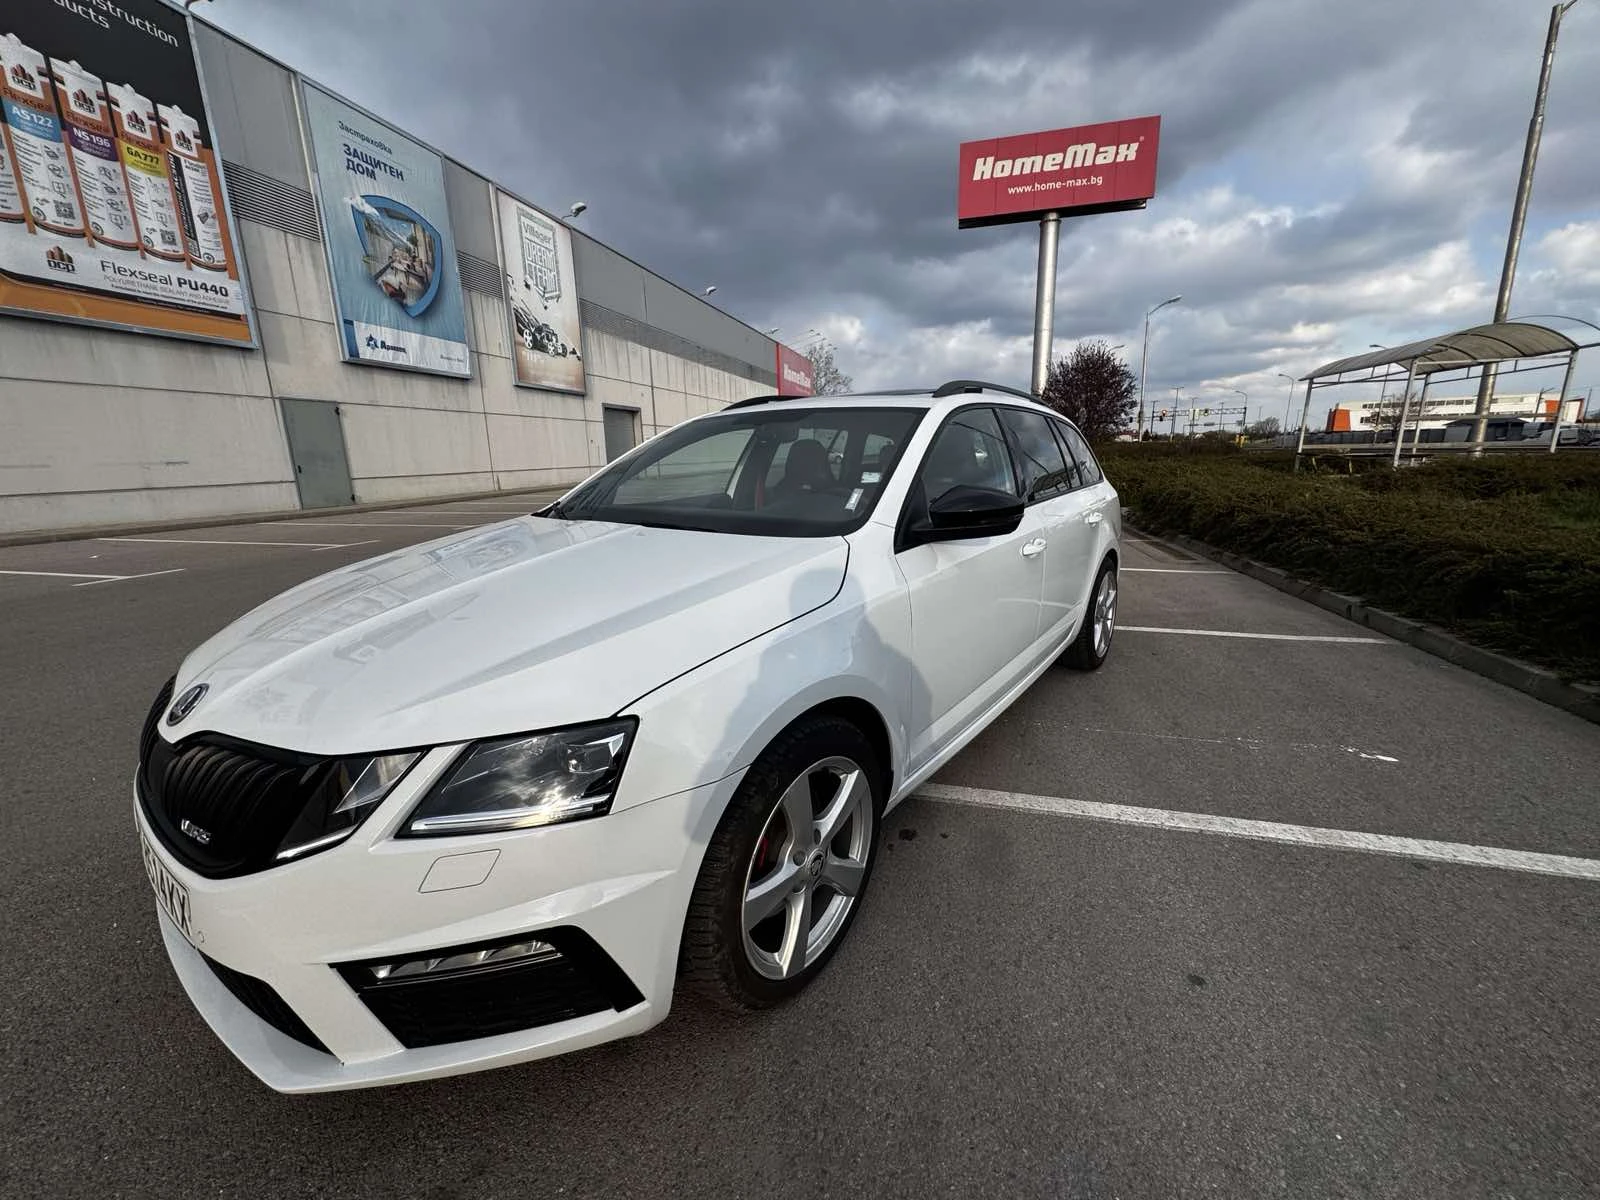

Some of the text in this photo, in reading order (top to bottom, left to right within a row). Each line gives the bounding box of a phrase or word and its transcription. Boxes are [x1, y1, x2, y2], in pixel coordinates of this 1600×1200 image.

[12, 105, 54, 128] AS122
[343, 143, 404, 181] ЗАЩИТЕН
[346, 158, 377, 181] ДОМ
[973, 142, 1139, 181] HomeMax
[1007, 175, 1103, 195] www.home-max.bg
[100, 260, 173, 287] Flexseal
[177, 277, 229, 297] PU440
